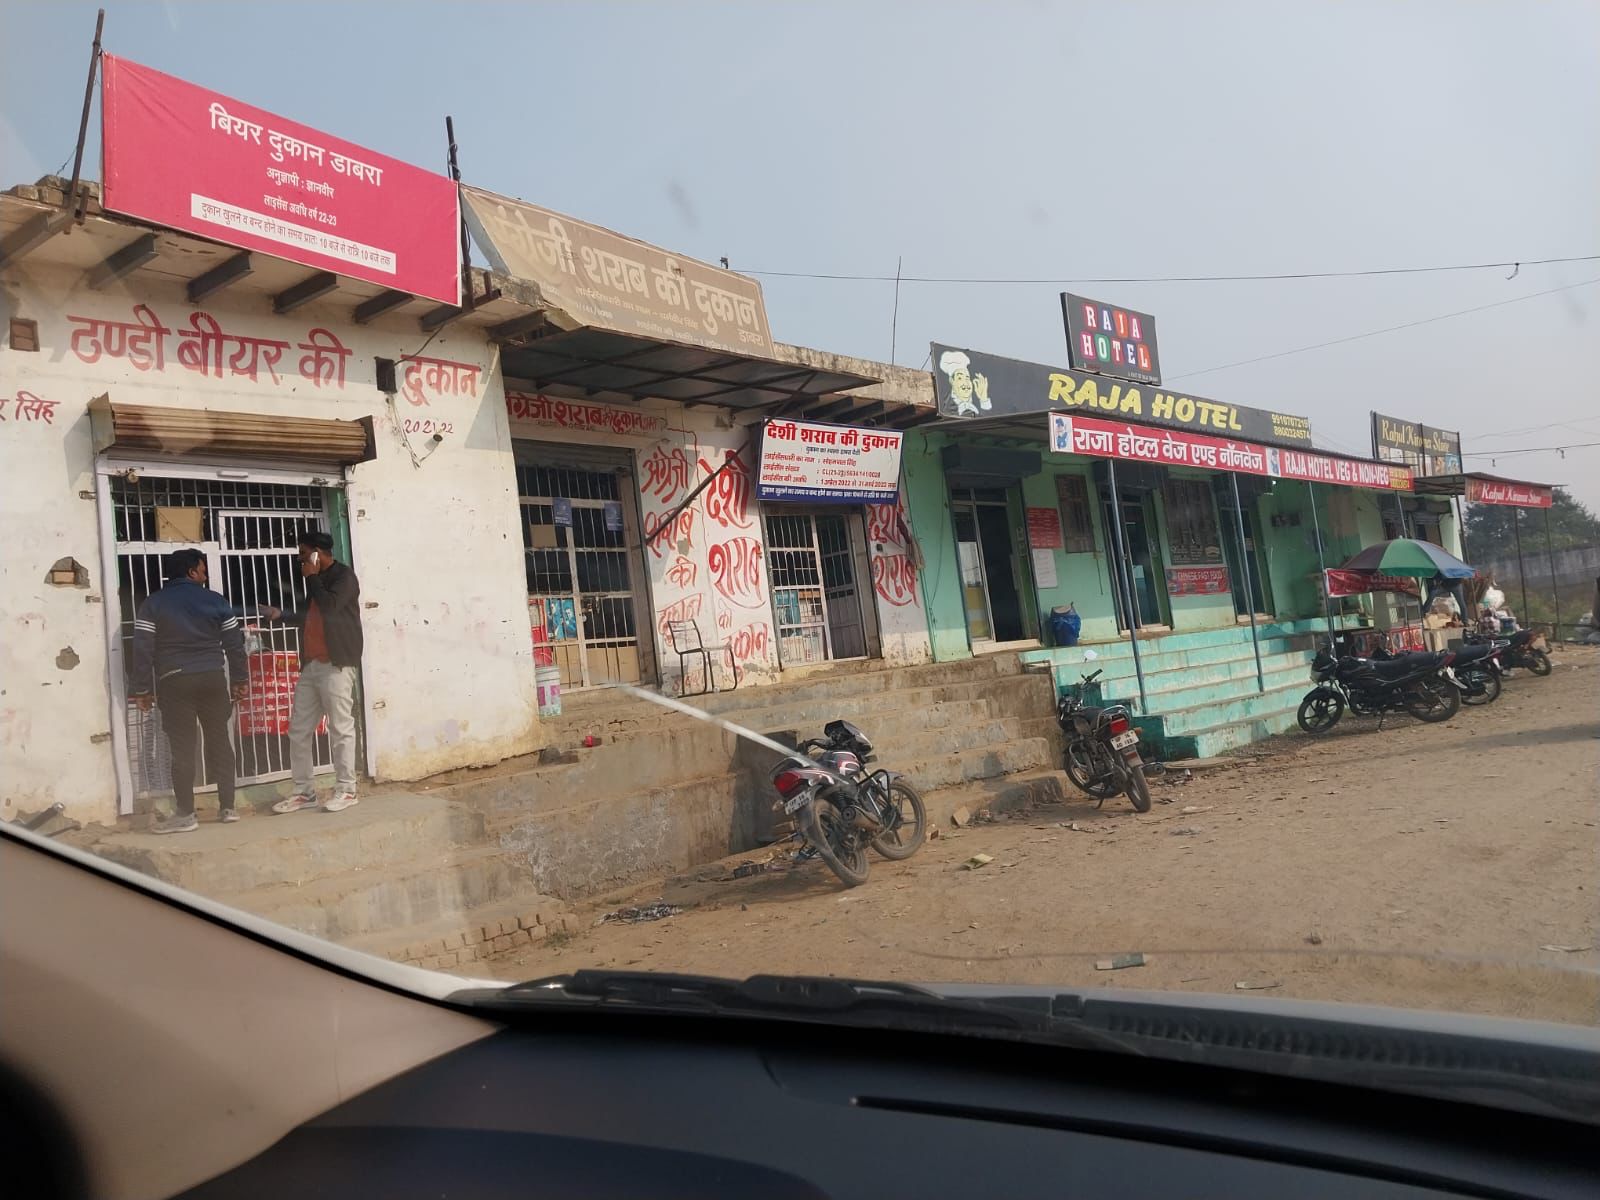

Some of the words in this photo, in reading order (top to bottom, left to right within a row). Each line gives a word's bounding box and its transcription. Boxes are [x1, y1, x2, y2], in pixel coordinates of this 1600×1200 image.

[209, 102, 263, 146] बियर
[268, 128, 325, 166] दुकान
[329, 151, 383, 187] डाबरा
[266, 167, 299, 187] अनुज्ञापी
[201, 202, 221, 218] दुकान
[223, 208, 242, 226] खुलने
[243, 214, 248, 222] व
[264, 219, 276, 234] होने
[277, 225, 286, 238] का
[320, 238, 328, 249] 10
[361, 250, 369, 260] 10
[289, 202, 308, 217] अवधि
[308, 206, 318, 221] वर्ष
[318, 211, 337, 227] 22-23
[580, 245, 649, 299] शराब
[651, 257, 691, 311] की
[690, 279, 761, 336] दुकान
[1085, 305, 1140, 338] RAJA
[67, 304, 172, 373] ठण्डी
[177, 312, 290, 386] बीयर
[298, 327, 354, 390] की
[401, 354, 482, 407] दुकान
[1082, 334, 1149, 368] HOTEL
[553, 401, 603, 427] शराब
[1048, 373, 1142, 415] RAJA
[1152, 393, 1242, 431] HOTEL
[767, 422, 797, 441] देशी
[800, 428, 838, 445] शराब
[840, 429, 860, 448] की
[862, 434, 901, 452] दुकान
[1073, 428, 1113, 453] राजा
[1117, 427, 1160, 459] होटल
[1162, 432, 1188, 461] वेज
[1190, 443, 1217, 466] एण्ड
[1219, 442, 1264, 471] नॉनवेज
[1284, 451, 1307, 476] RAJA
[1308, 456, 1334, 480] HOTEL
[1334, 460, 1351, 481] VEG
[1352, 463, 1358, 482] &
[1359, 463, 1389, 486] NON-VEG
[709, 536, 767, 609] शराब
